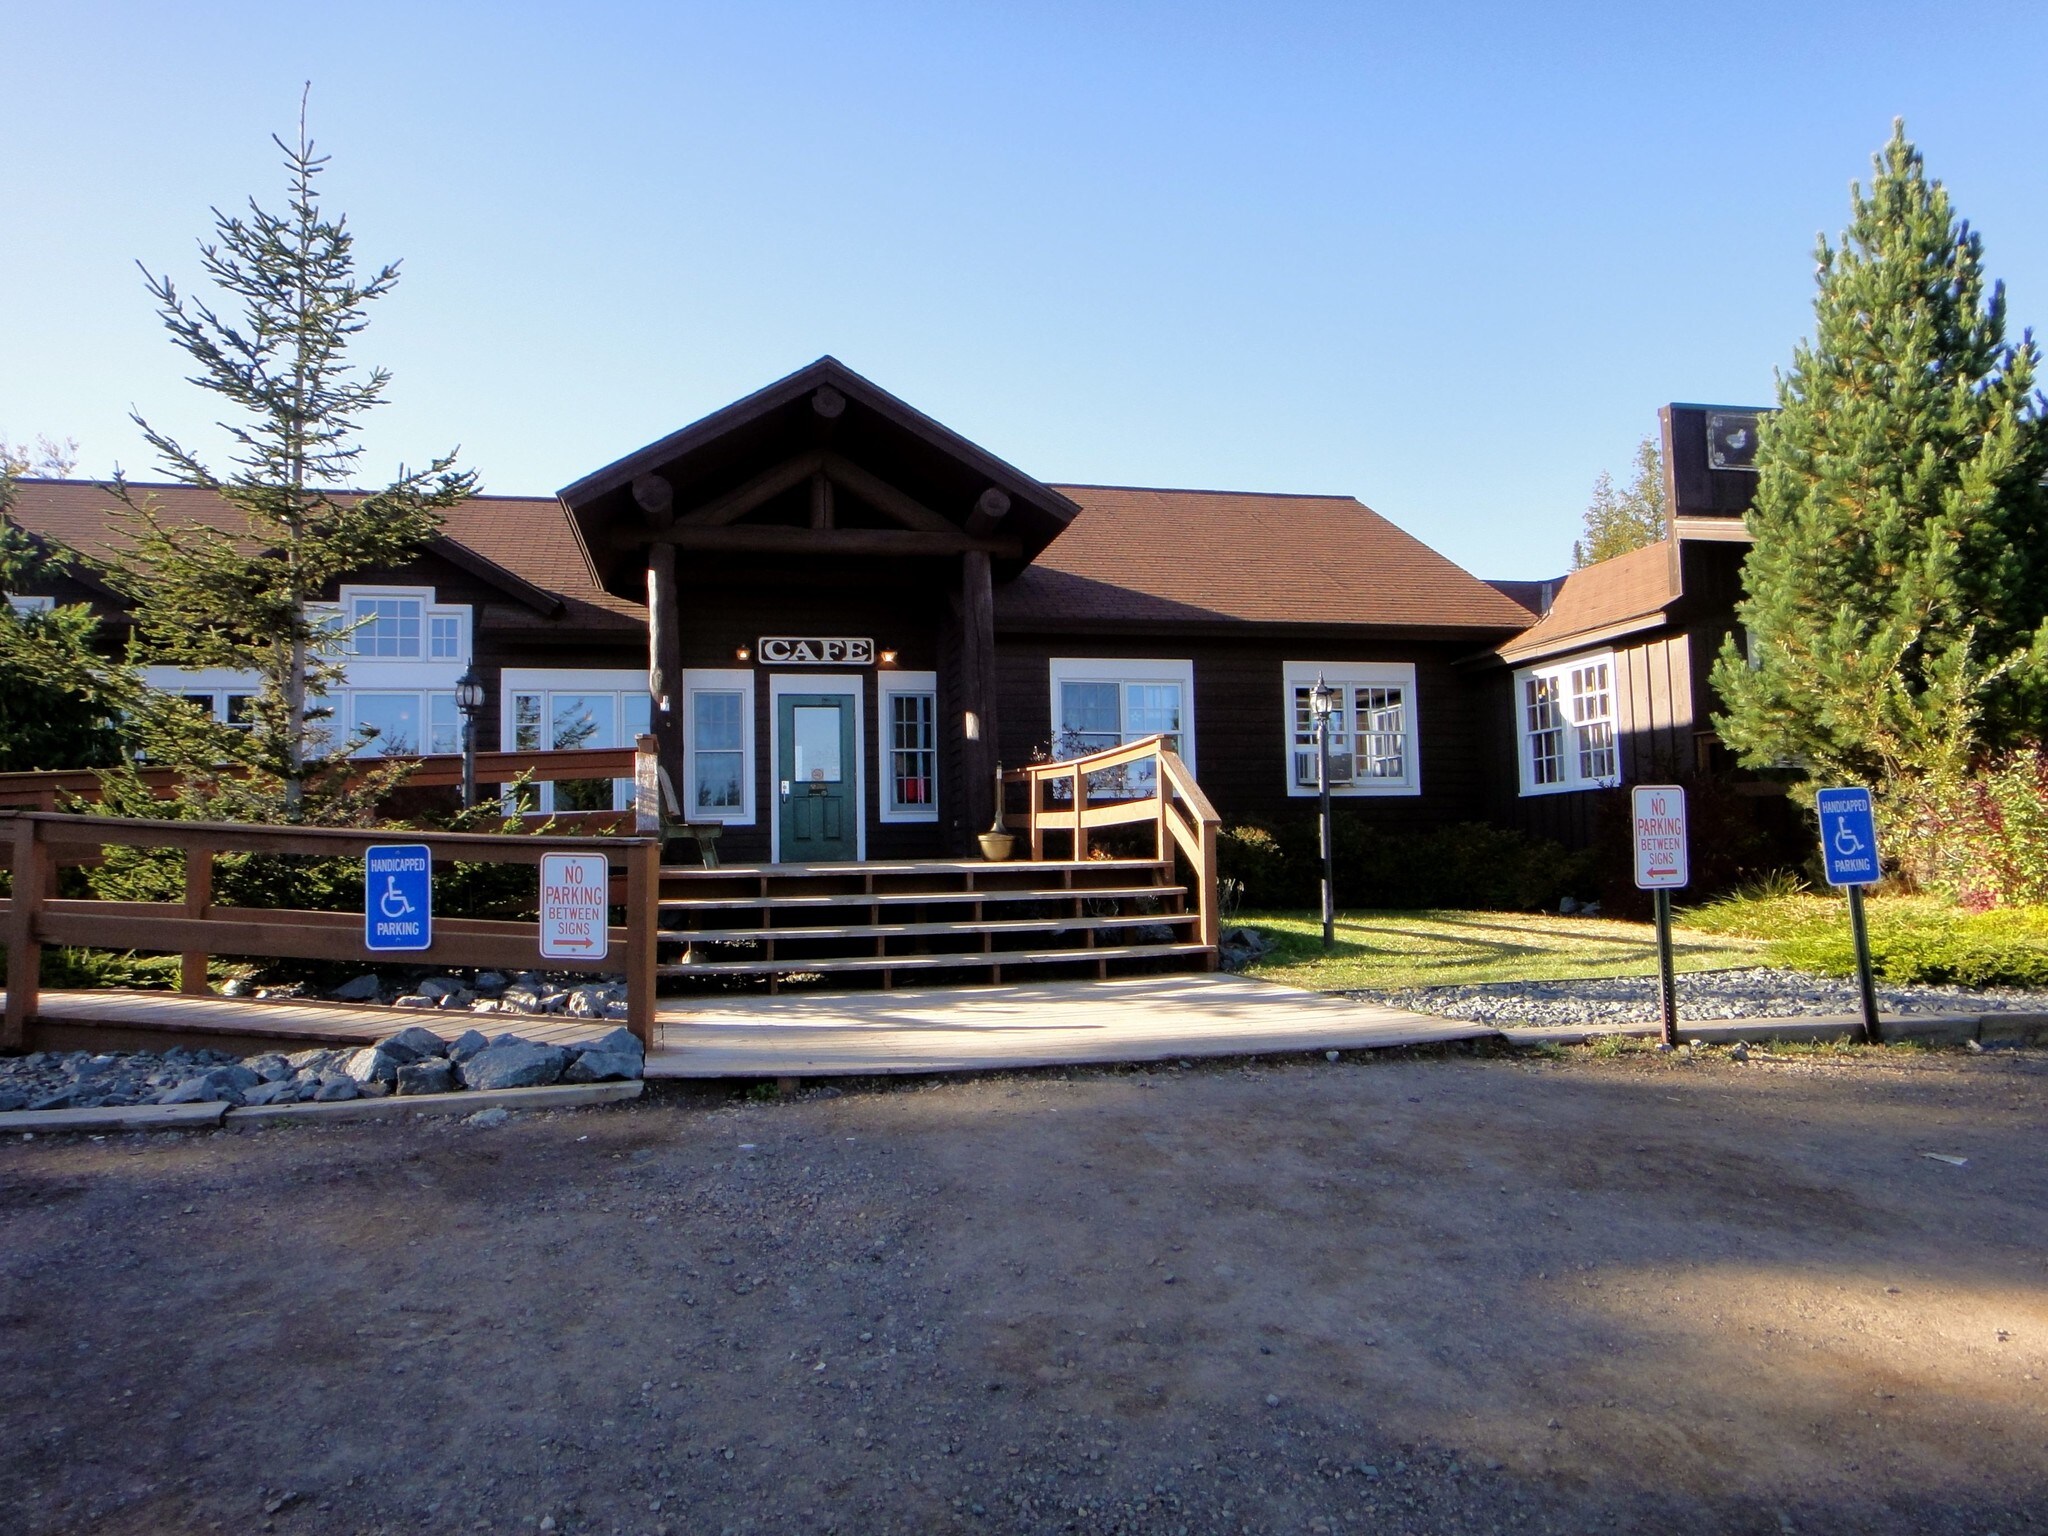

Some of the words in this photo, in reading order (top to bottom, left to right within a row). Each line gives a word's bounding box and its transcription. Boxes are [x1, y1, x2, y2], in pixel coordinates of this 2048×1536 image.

[764, 640, 869, 662] CAFE
[1651, 798, 1666, 815] NO
[1822, 799, 1868, 813] HANDICAPPED
[1638, 818, 1682, 836] PARKING
[1641, 838, 1680, 850] BETWEEN
[371, 858, 425, 872] HANDICAPPED
[1649, 852, 1674, 865] SIGNS
[1834, 858, 1871, 872] PARKING
[565, 866, 583, 884] NO
[546, 887, 601, 905] PARKING
[549, 908, 599, 920] BETWEEN
[377, 922, 419, 936] PARKING
[558, 922, 590, 935] SIGNS
